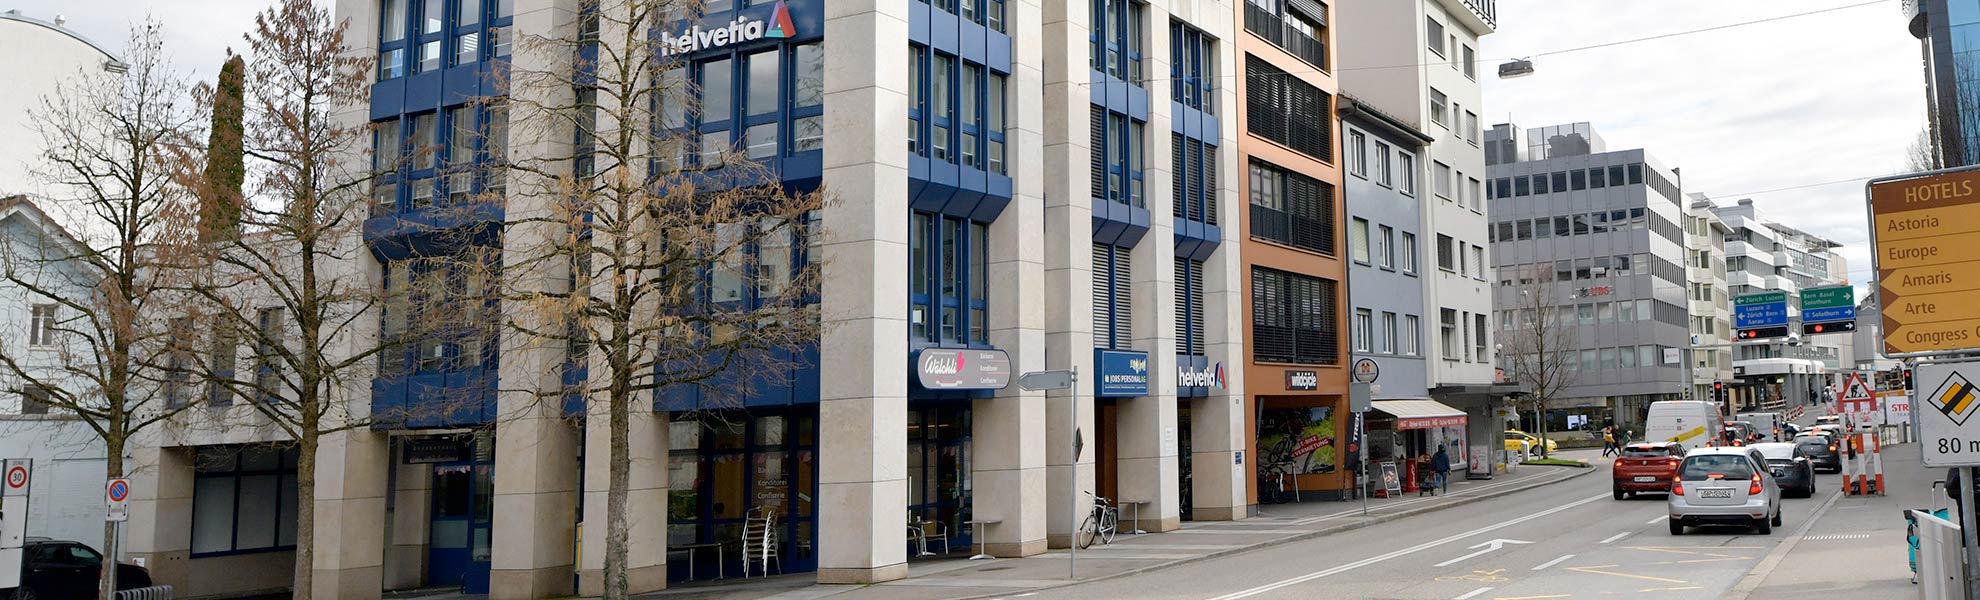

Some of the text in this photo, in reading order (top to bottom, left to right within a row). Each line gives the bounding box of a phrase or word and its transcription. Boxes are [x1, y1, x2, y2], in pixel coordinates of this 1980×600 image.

[662, 15, 764, 57] helvetia
[1905, 180, 1973, 203] HOTELS
[1887, 215, 1939, 232] Astoria
[1889, 246, 1938, 260] Europe
[1902, 271, 1952, 287] Amaris
[1590, 286, 1611, 297] UBS
[1905, 302, 1936, 315] Arte
[1906, 328, 1968, 345] Congress
[1178, 366, 1215, 387] helvetia
[1938, 437, 1961, 454] 80
[13, 473, 22, 482] 30
